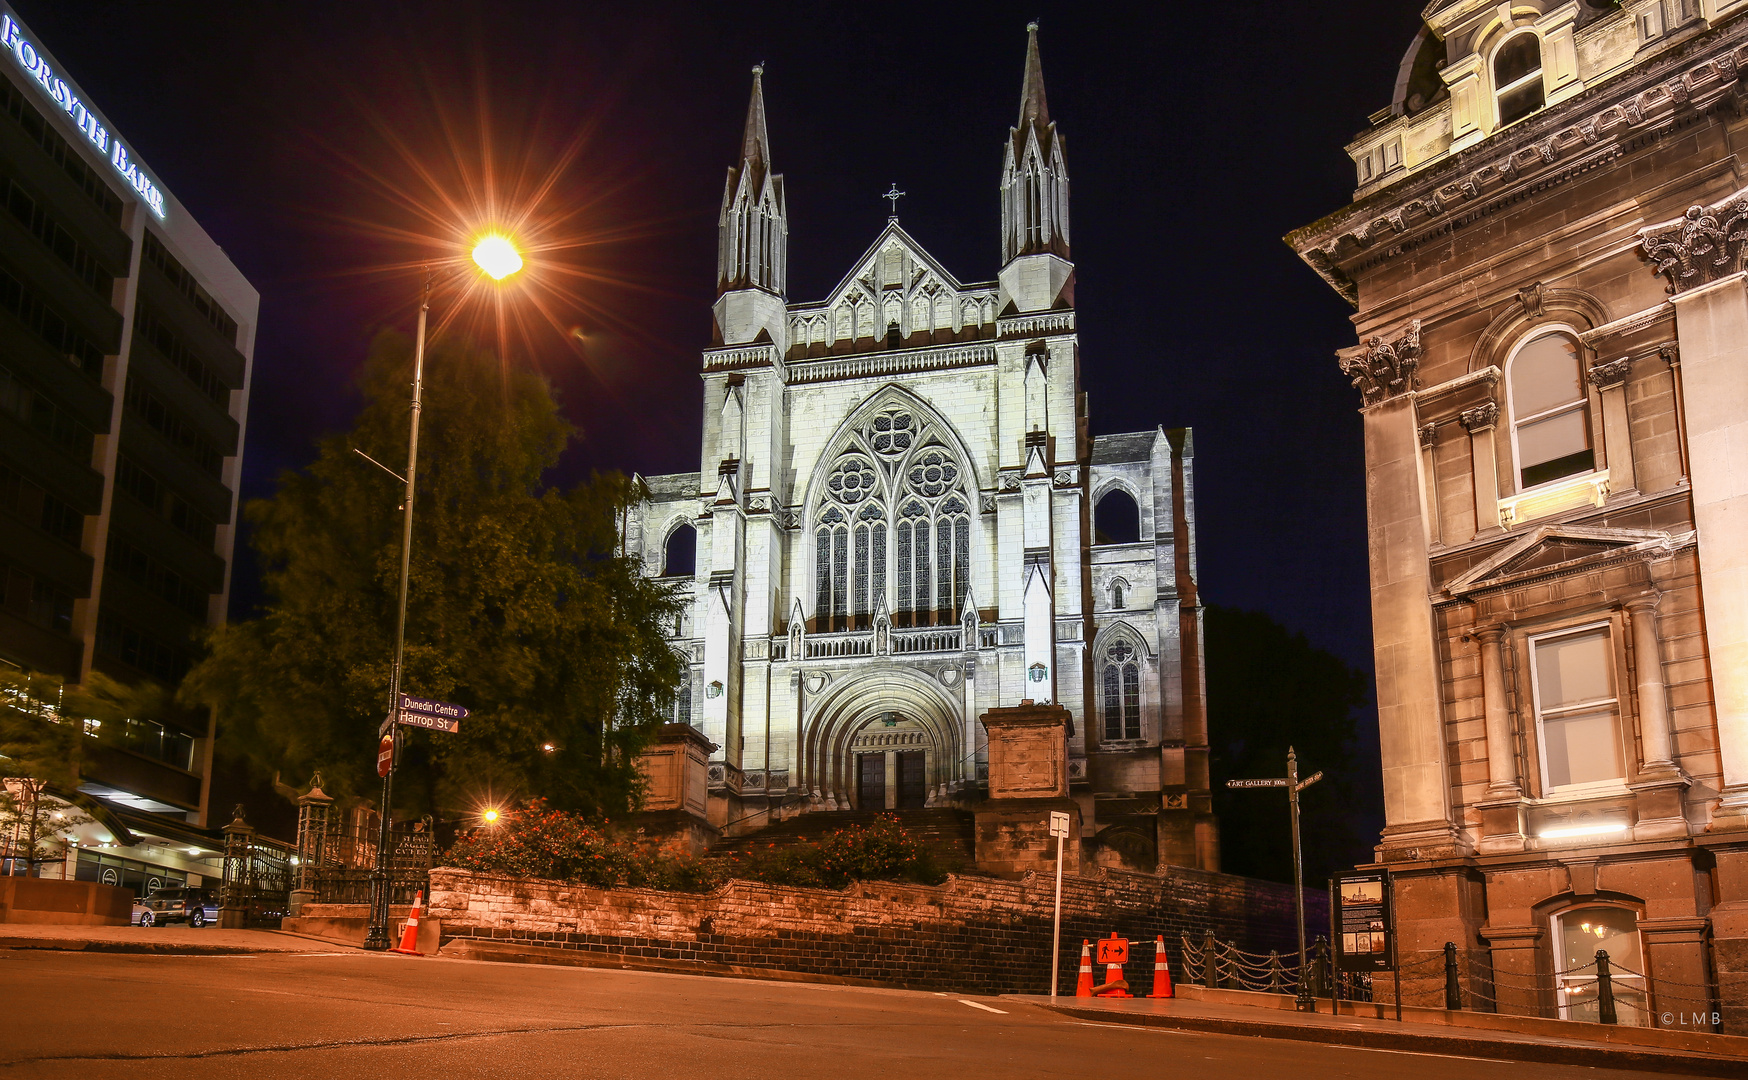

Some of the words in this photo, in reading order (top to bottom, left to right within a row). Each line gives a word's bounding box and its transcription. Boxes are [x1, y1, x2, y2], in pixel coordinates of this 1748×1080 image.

[1, 14, 109, 154] FORSYTH
[112, 140, 166, 219] BARR
[404, 697, 433, 712] Dunedin
[434, 703, 458, 717] Centre
[400, 710, 434, 727] Harrop
[437, 717, 449, 730] St
[395, 848, 441, 856] CATHEDAL
